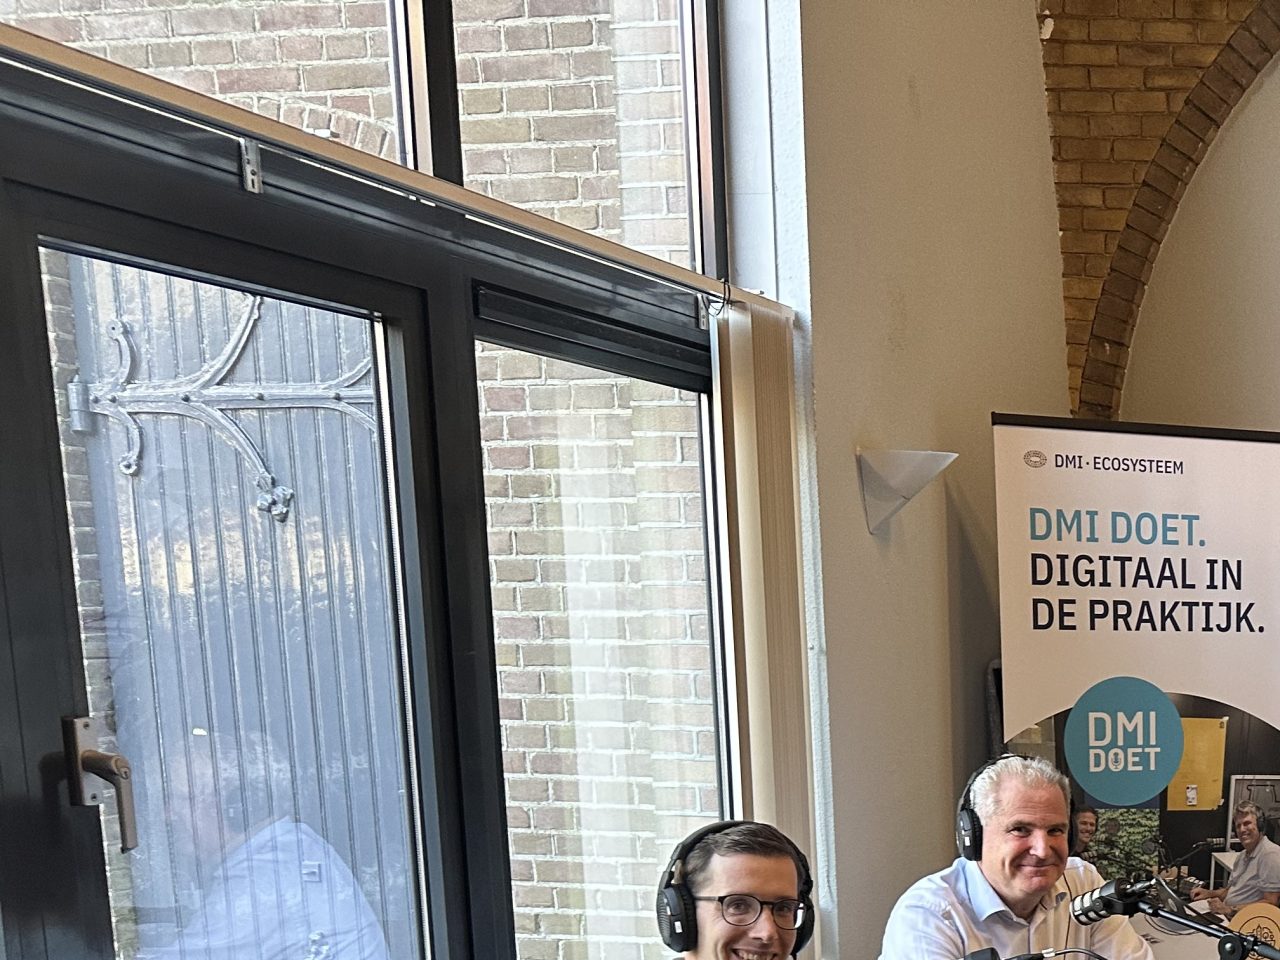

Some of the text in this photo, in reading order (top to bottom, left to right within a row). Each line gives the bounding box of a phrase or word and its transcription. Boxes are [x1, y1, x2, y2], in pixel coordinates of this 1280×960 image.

[1030, 507, 1206, 547] DMI DOET.
[1031, 553, 1241, 590] DIGITAAL IN
[1032, 598, 1264, 632] DE PRAKTIJK.
[1089, 712, 1155, 746] DMI
[1089, 748, 1161, 772] DOET
